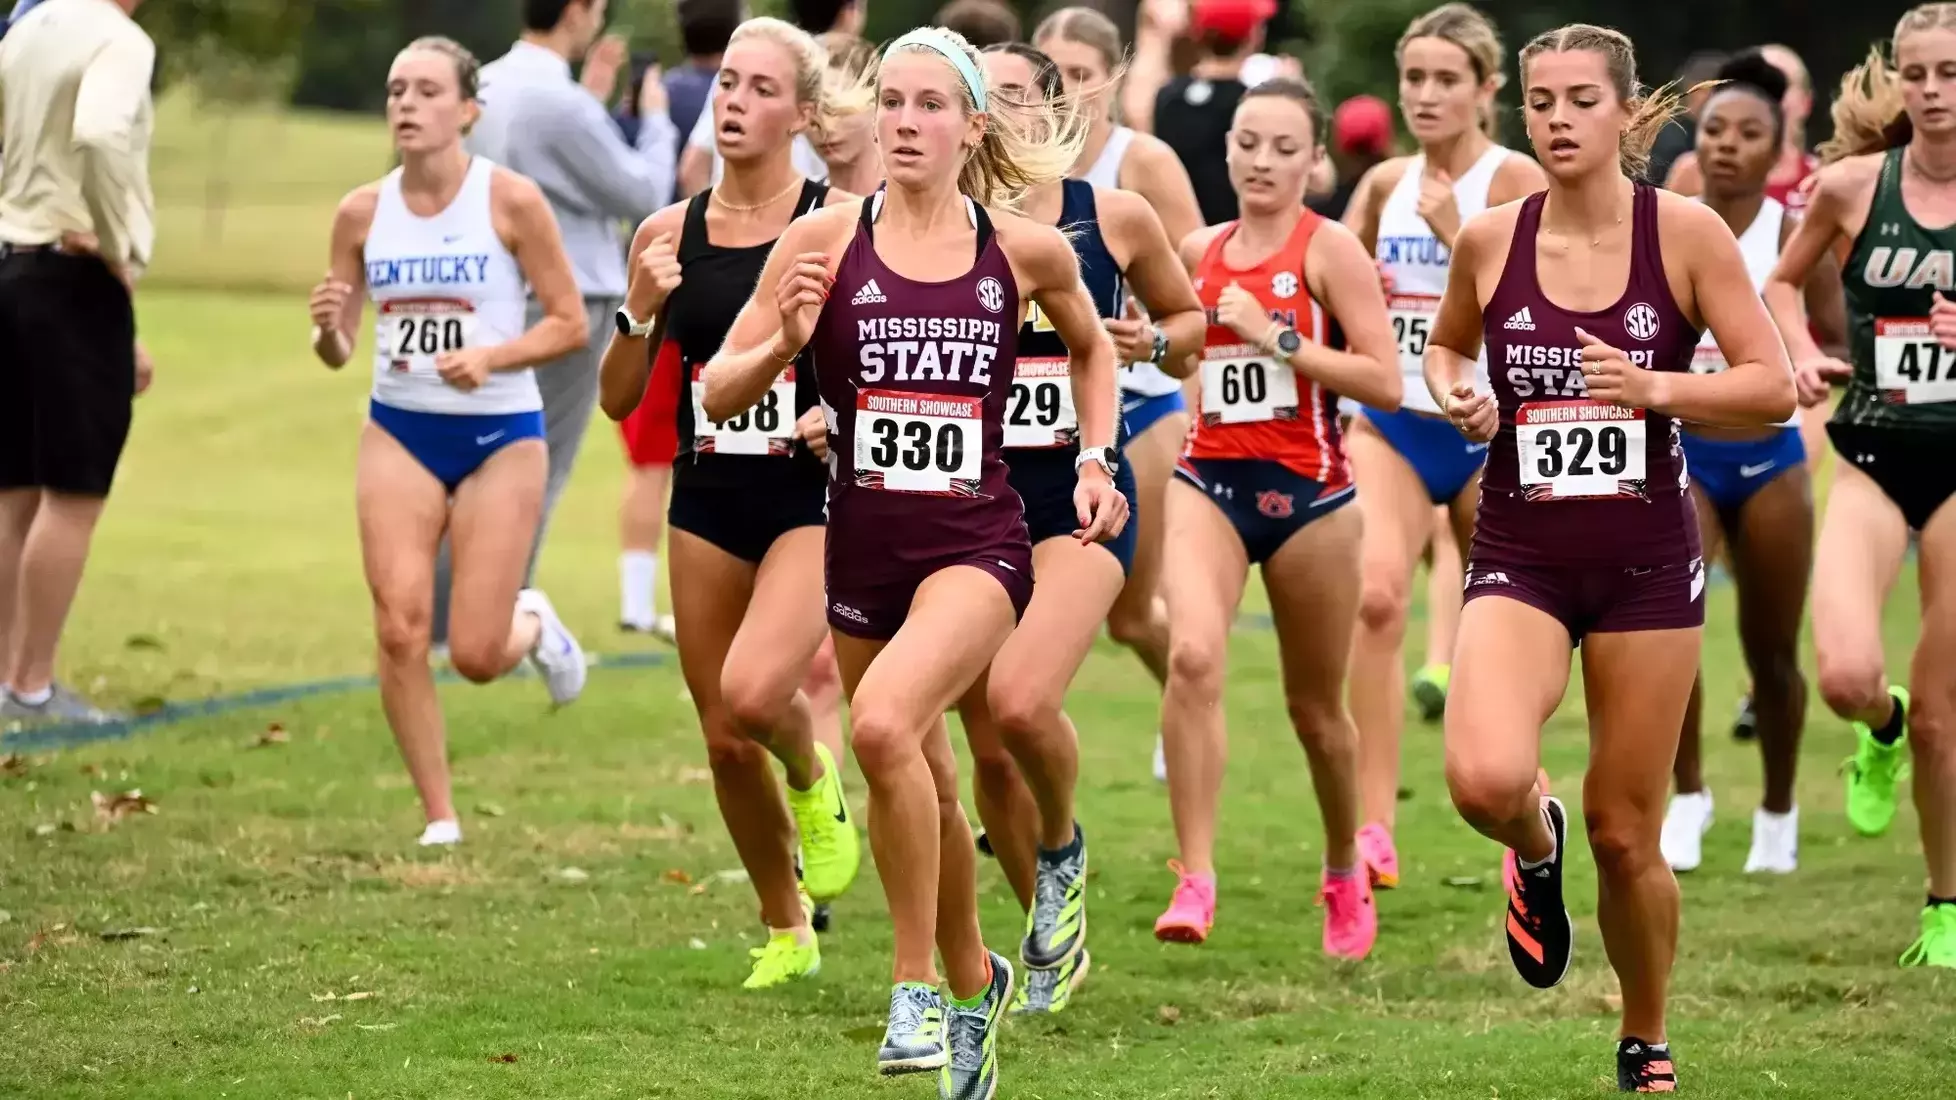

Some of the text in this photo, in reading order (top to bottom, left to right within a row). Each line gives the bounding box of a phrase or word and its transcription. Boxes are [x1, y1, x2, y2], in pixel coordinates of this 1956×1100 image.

[364, 255, 489, 288] KENTUCKY
[1863, 246, 1956, 290] UA
[851, 294, 888, 306] adidas
[978, 279, 1004, 311] SEC
[399, 318, 464, 355] 260
[857, 317, 1001, 344] MISSISSIPPI
[1392, 316, 1428, 355] 25
[1503, 321, 1536, 331] adidas
[1626, 303, 1658, 339] SEC
[859, 341, 998, 387] STATE
[1505, 344, 1655, 369] MISSISPI
[1222, 363, 1267, 405] 60
[1506, 367, 1590, 398] STA
[867, 395, 974, 418] SOUTHERN SHOWCASE
[1009, 383, 1060, 426] 29
[1526, 405, 1635, 423] SOUTHERN SHOWCASE
[871, 418, 964, 473] 330
[1535, 426, 1627, 478] 329
[832, 603, 869, 624] adidas
